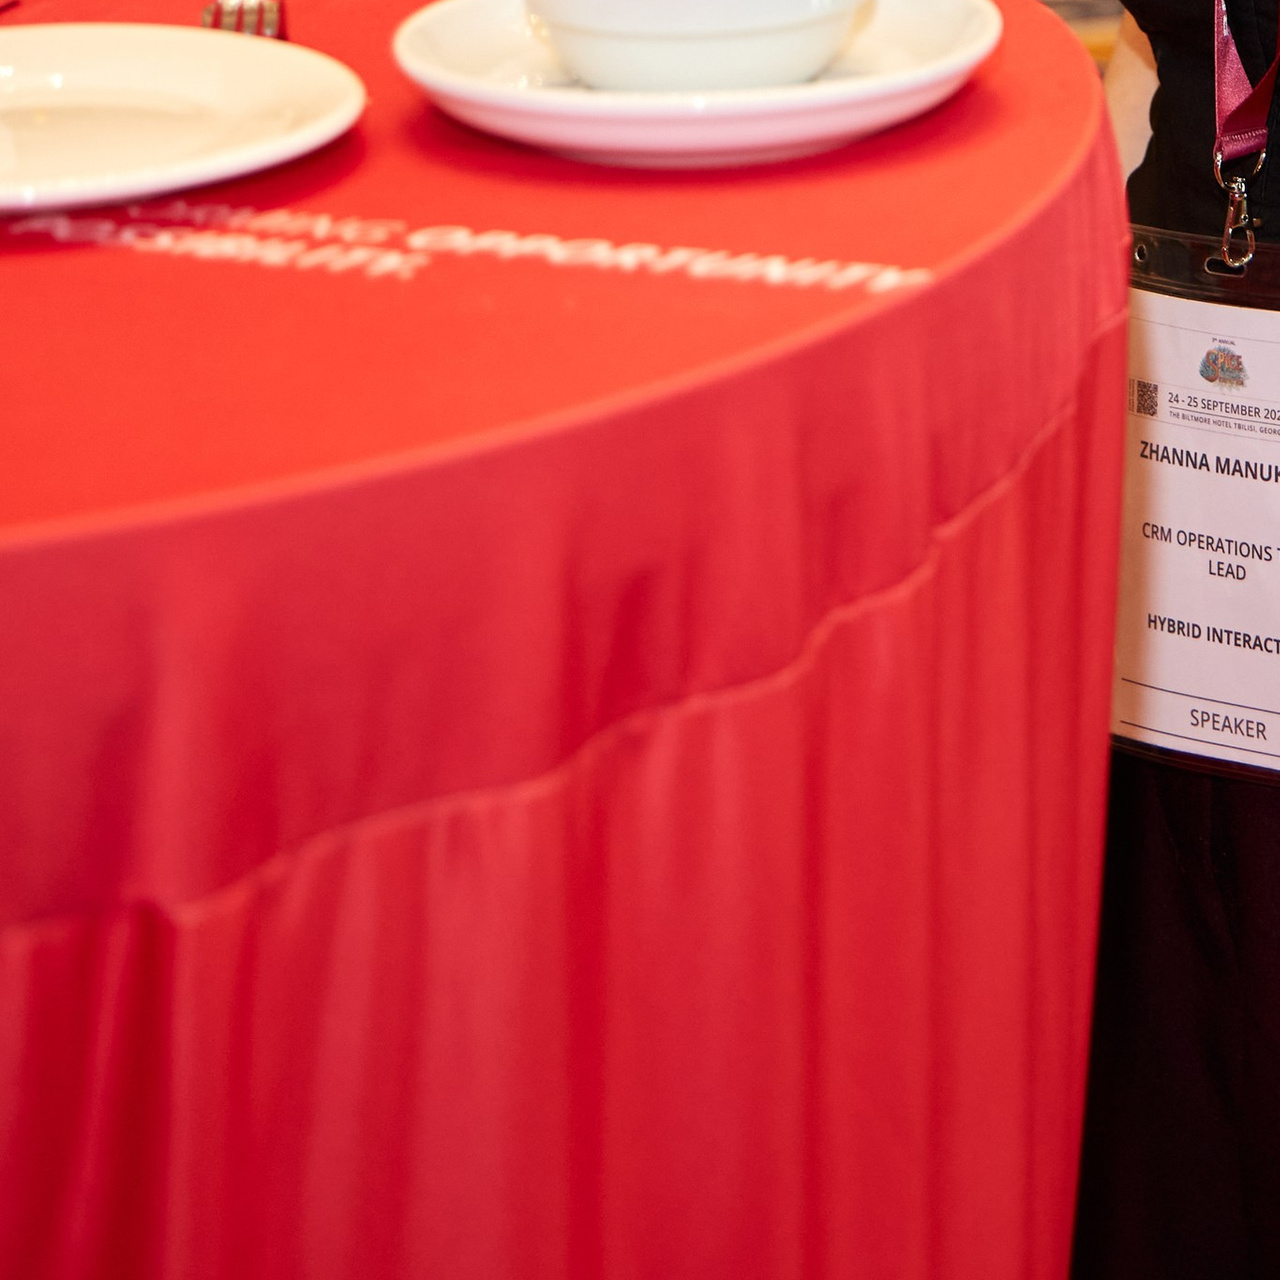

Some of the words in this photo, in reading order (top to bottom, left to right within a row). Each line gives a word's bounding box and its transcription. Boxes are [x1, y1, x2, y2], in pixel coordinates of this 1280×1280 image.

[1168, 392, 1179, 404] 24
[1187, 395, 1199, 408] 25
[1201, 398, 1261, 418] SEPTEMBER
[1169, 410, 1180, 420] THE
[1181, 413, 1211, 425] BILTMORE
[1212, 419, 1232, 429] HOTEL
[1139, 440, 1211, 472] ZHANNA
[1142, 522, 1172, 543] CRM
[1176, 529, 1273, 562] OPERATIONS
[1208, 559, 1247, 581] LEAD
[1147, 613, 1202, 639] HYBRID
[1190, 708, 1268, 741] SPEAKER
